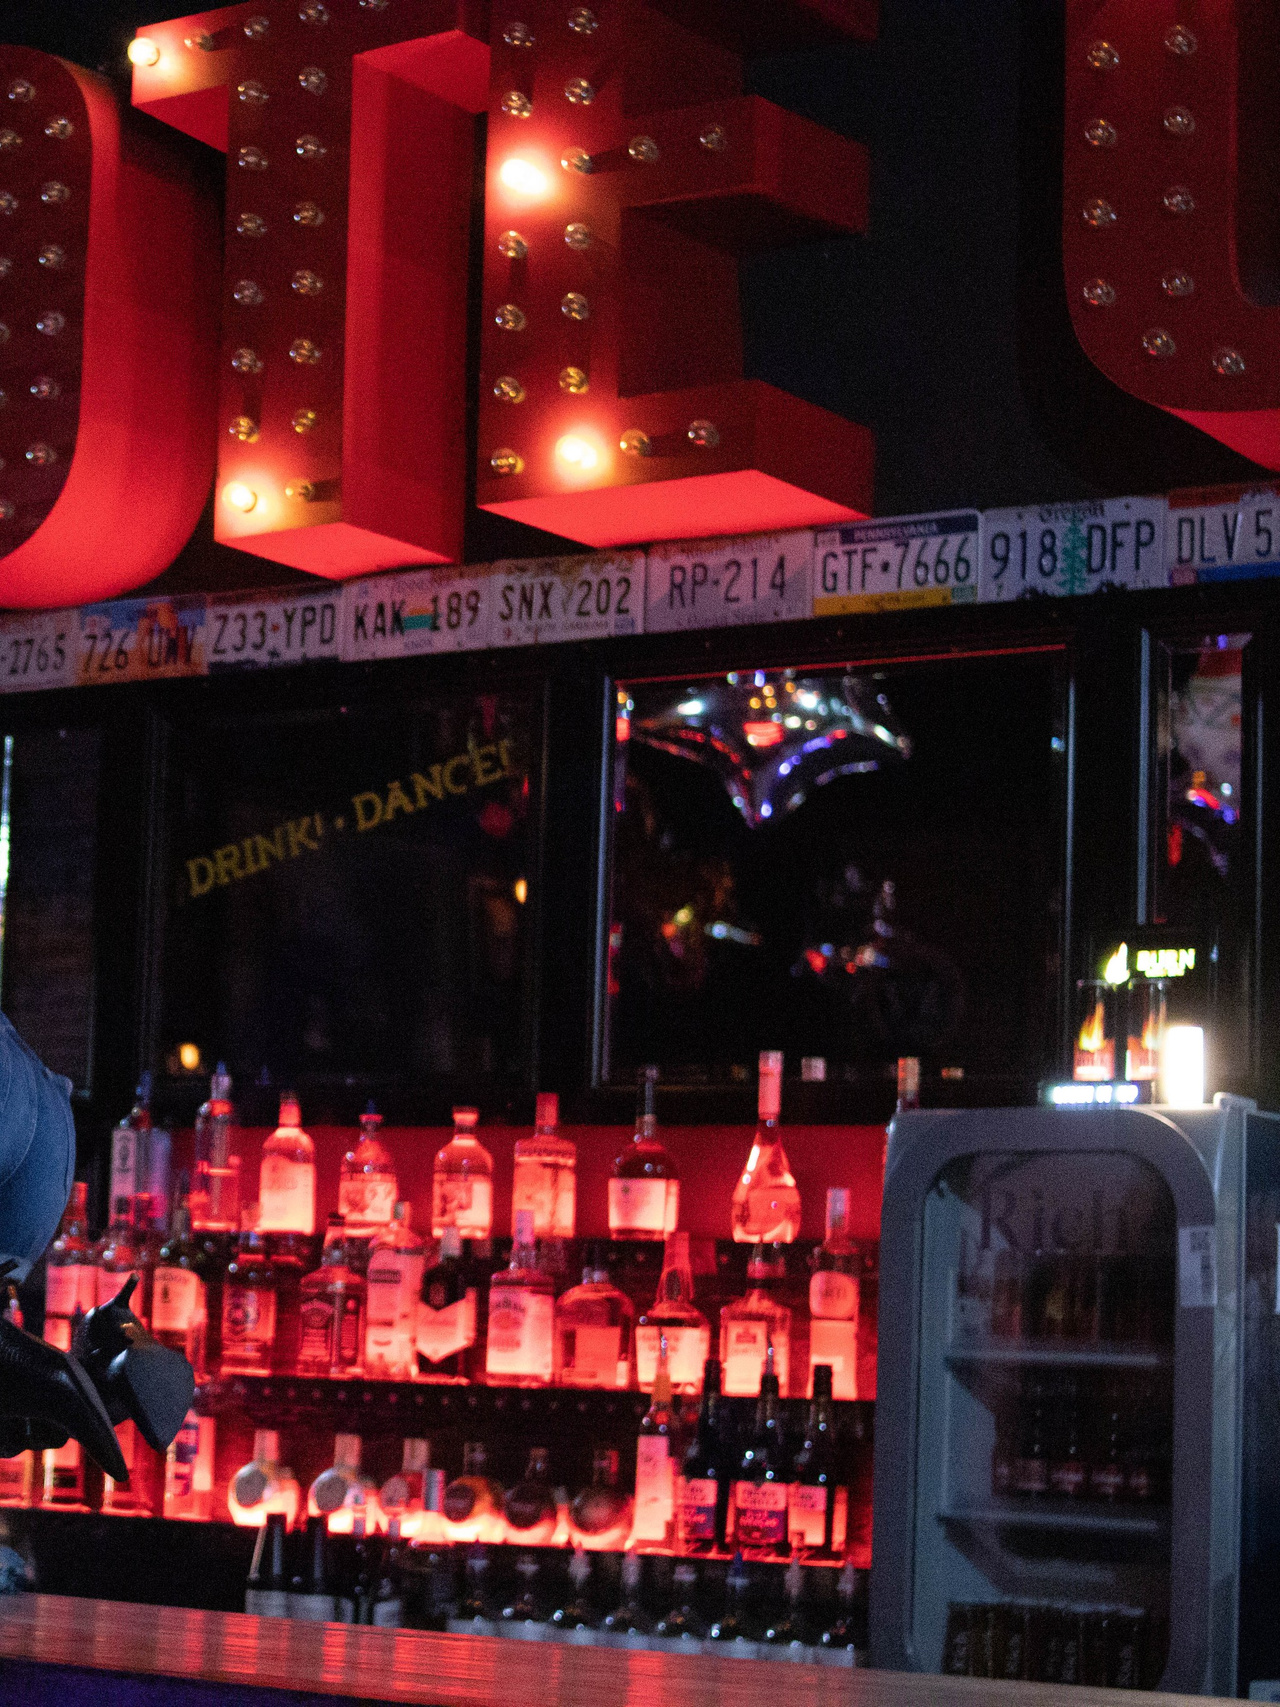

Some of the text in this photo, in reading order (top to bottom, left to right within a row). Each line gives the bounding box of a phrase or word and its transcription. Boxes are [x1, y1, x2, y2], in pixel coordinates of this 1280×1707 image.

[990, 519, 1156, 580] 918 DFP
[1177, 511, 1239, 564] DLV
[353, 590, 481, 641] KAK 189
[500, 577, 632, 621] SNX 202
[83, 629, 129, 672] 726
[978, 1184, 1131, 1252] Rich
